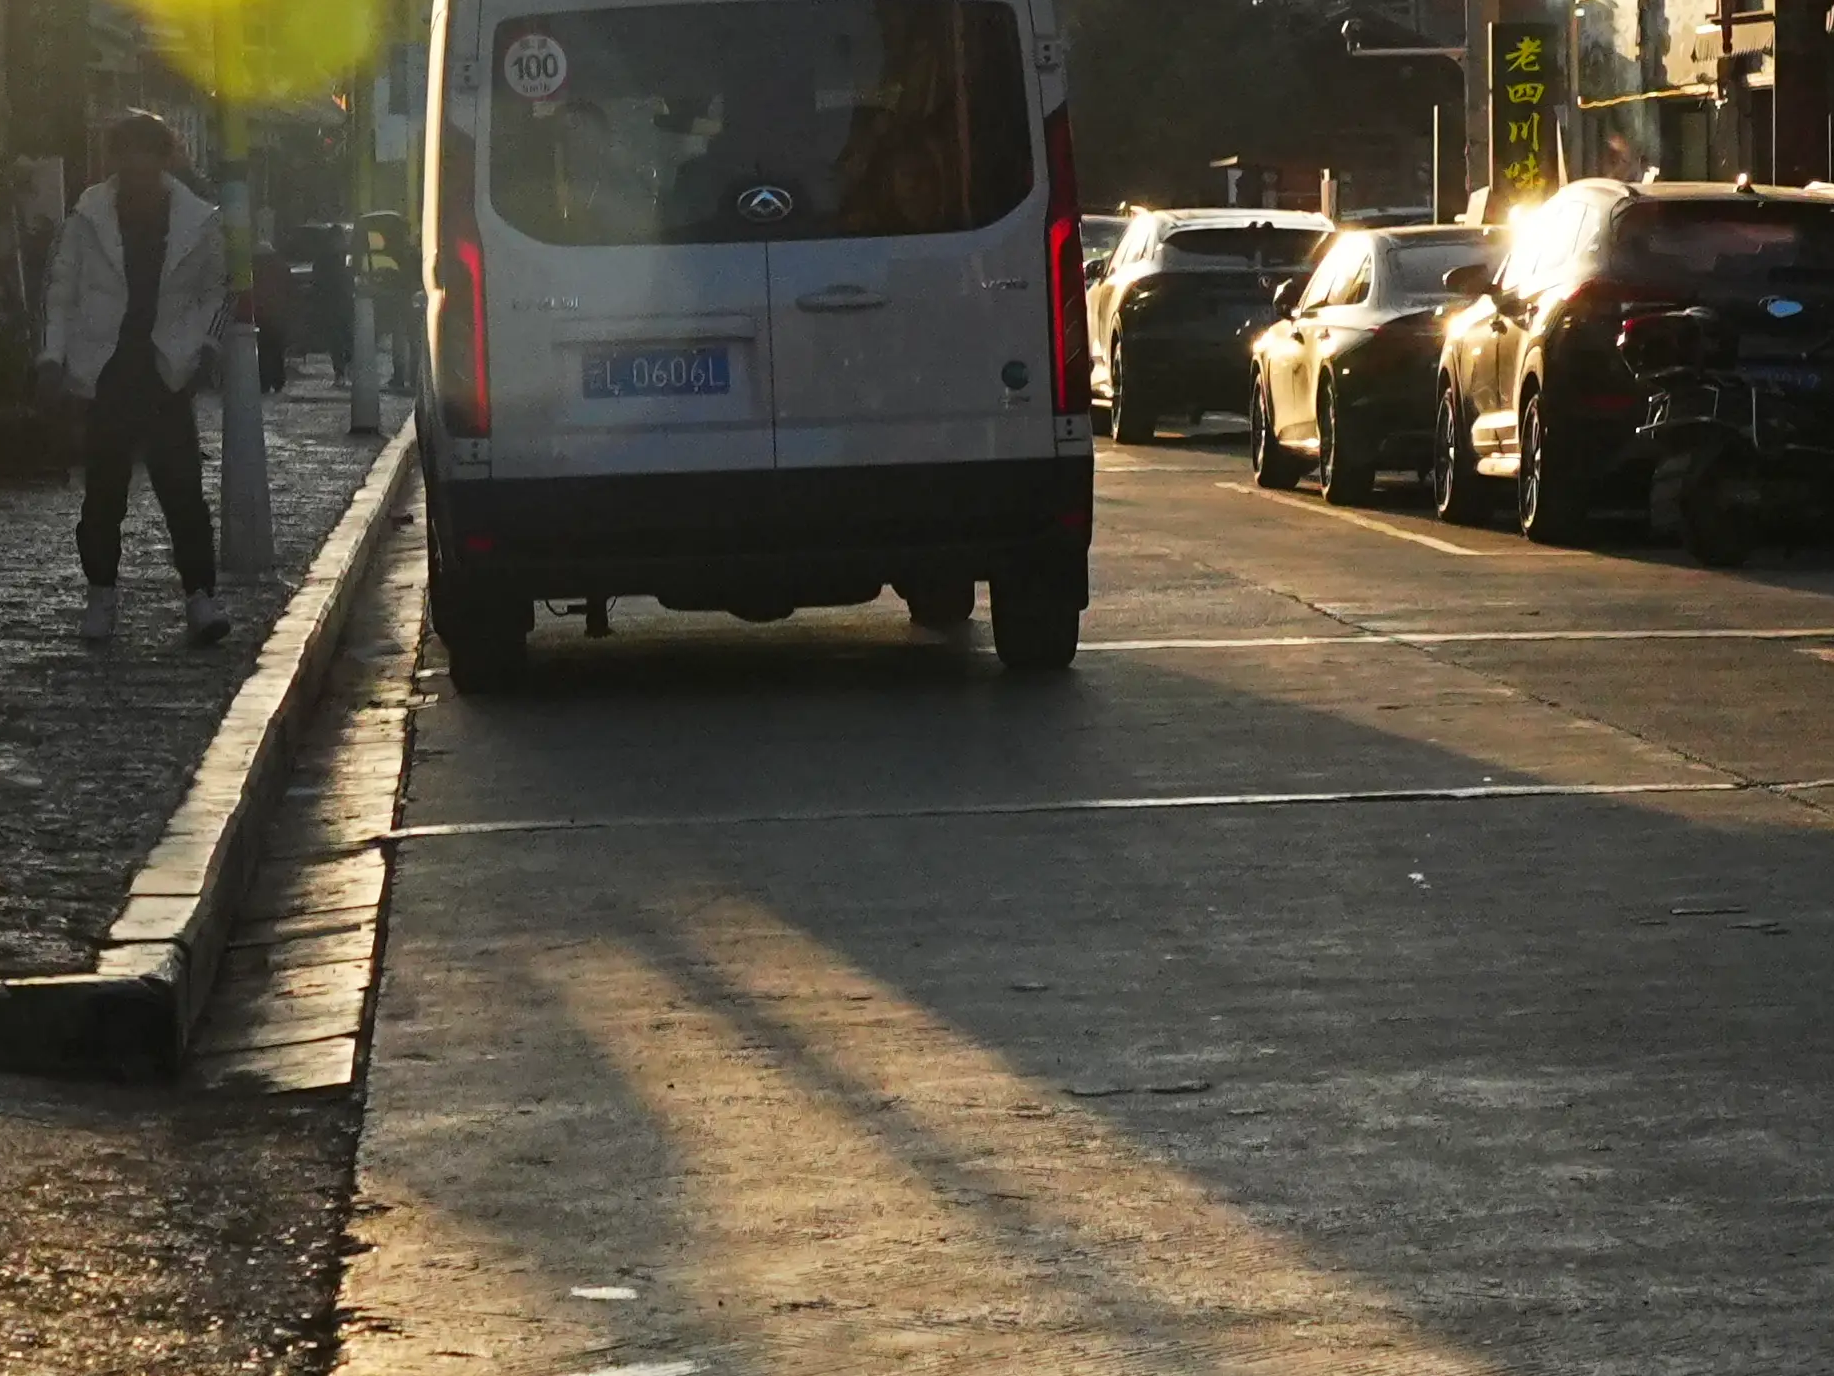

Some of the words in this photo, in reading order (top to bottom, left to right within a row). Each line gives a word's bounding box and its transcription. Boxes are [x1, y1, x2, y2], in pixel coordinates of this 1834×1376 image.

[509, 53, 559, 81] 100
[1504, 35, 1547, 191] 老四川味
